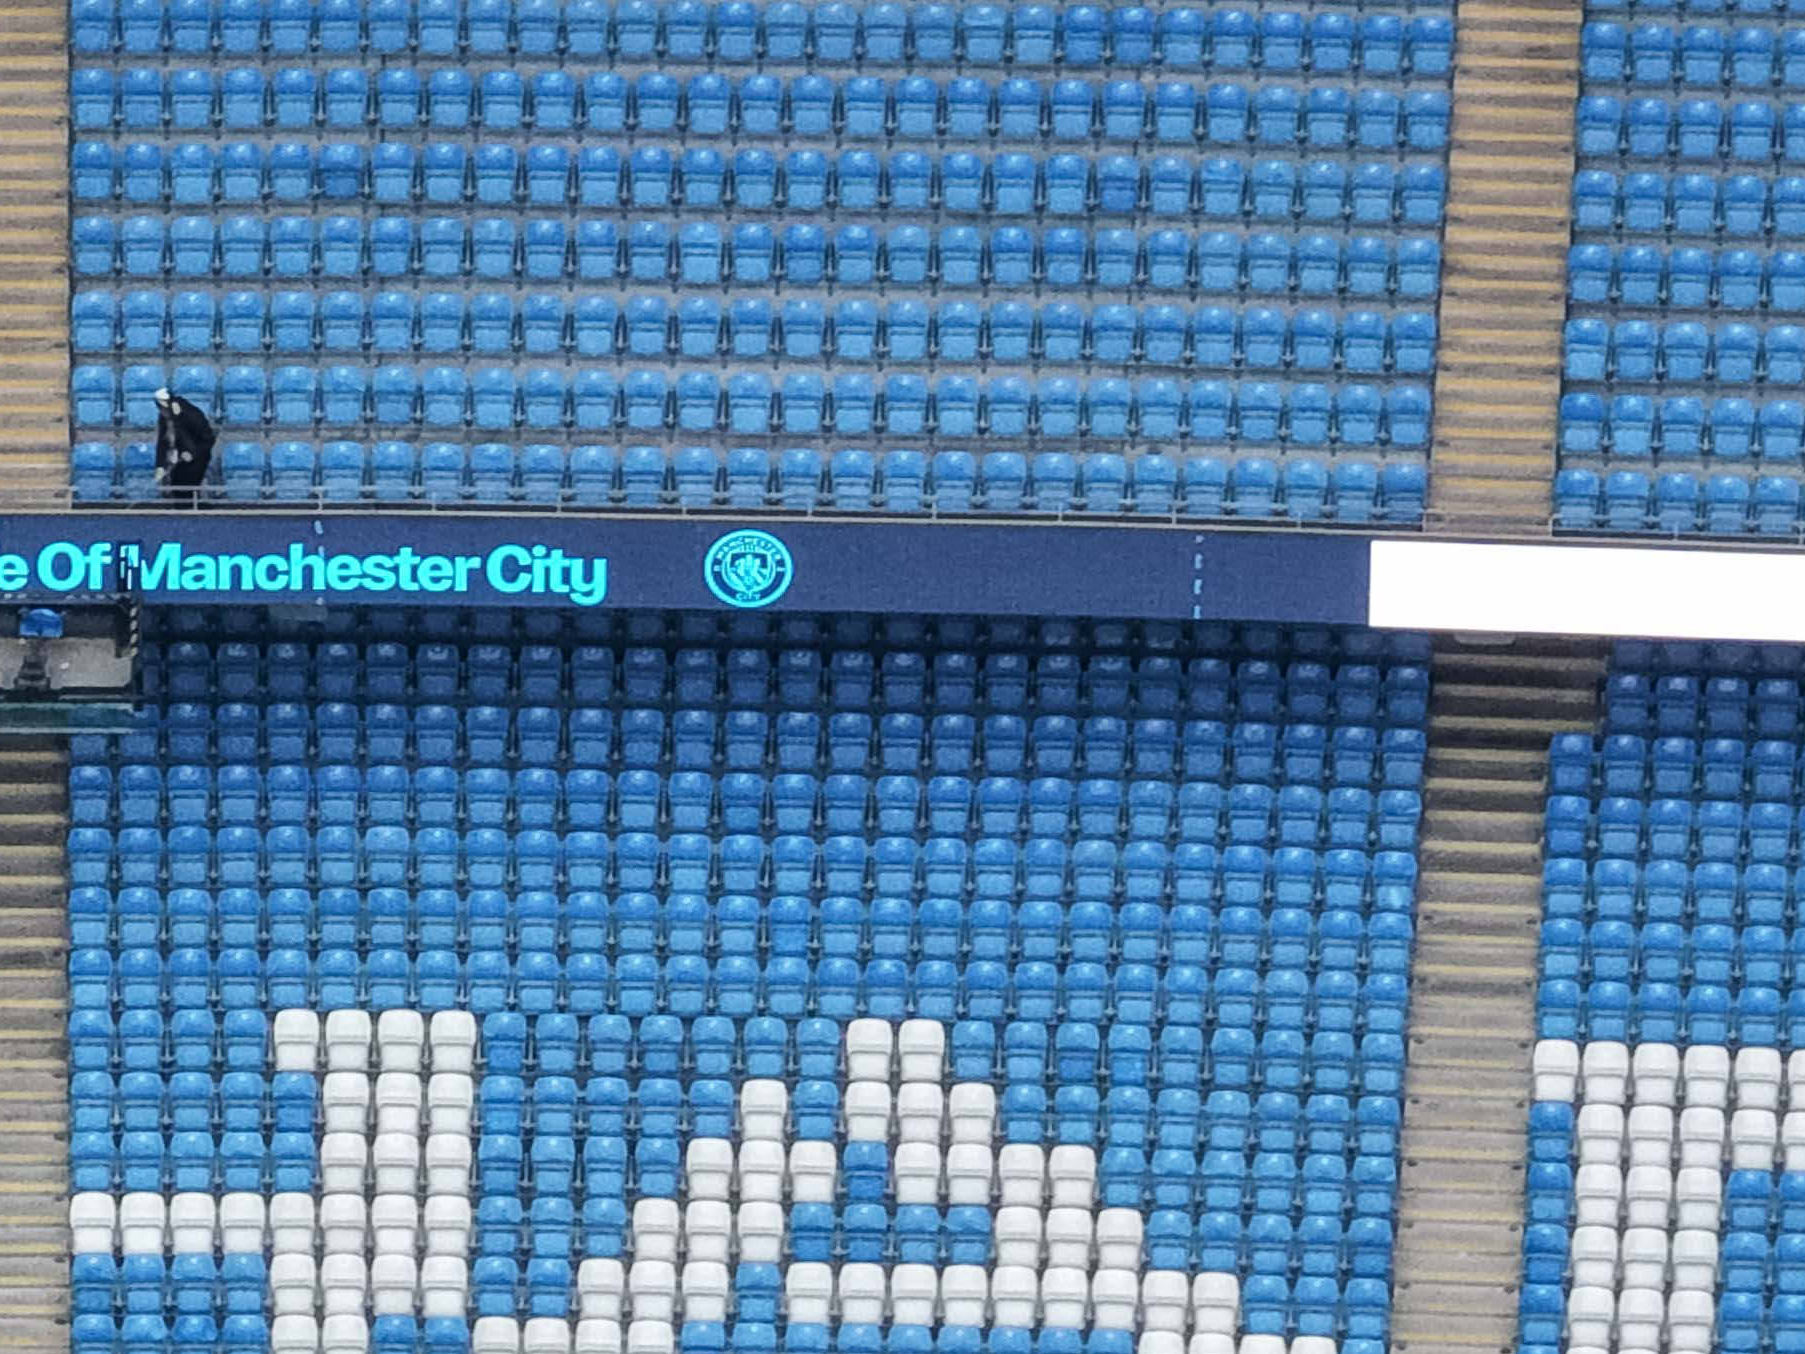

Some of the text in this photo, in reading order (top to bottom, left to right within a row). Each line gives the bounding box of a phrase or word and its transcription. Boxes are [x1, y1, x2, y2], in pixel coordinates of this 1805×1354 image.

[37, 542, 113, 591] Of
[120, 543, 482, 592] Manchester
[486, 544, 607, 606] City
